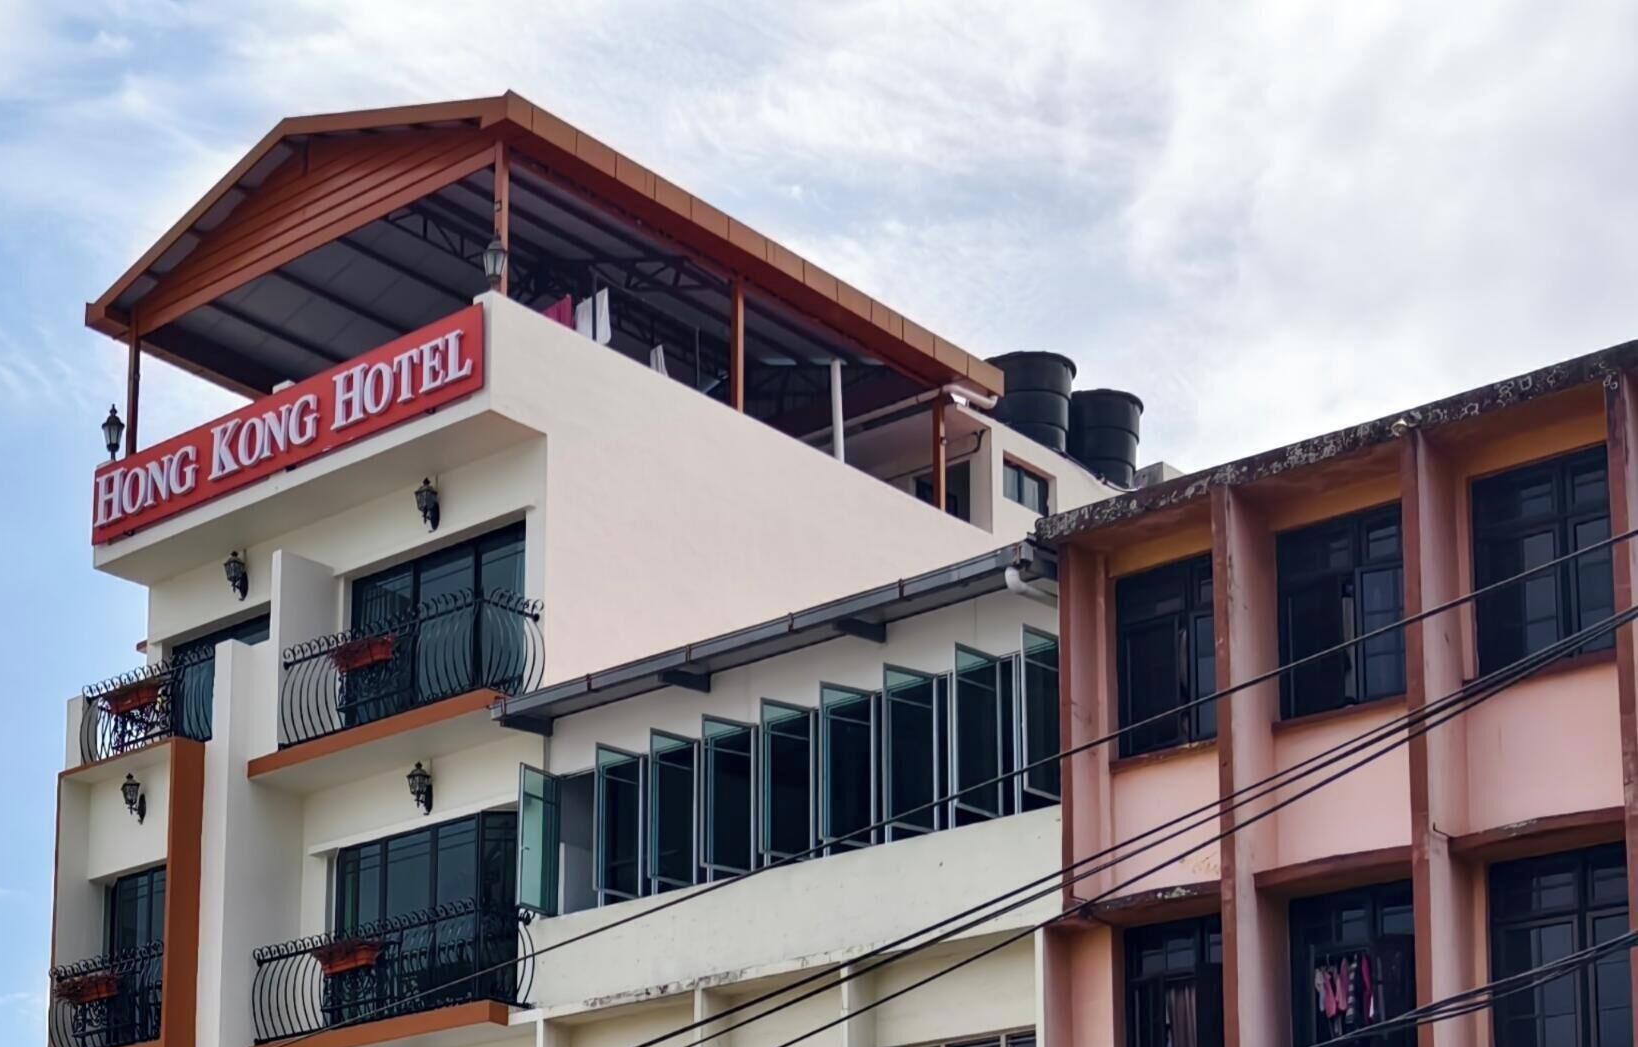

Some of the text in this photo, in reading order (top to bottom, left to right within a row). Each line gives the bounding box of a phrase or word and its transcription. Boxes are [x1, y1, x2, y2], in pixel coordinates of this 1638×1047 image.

[95, 328, 473, 528] HONG KONG HOTEL
